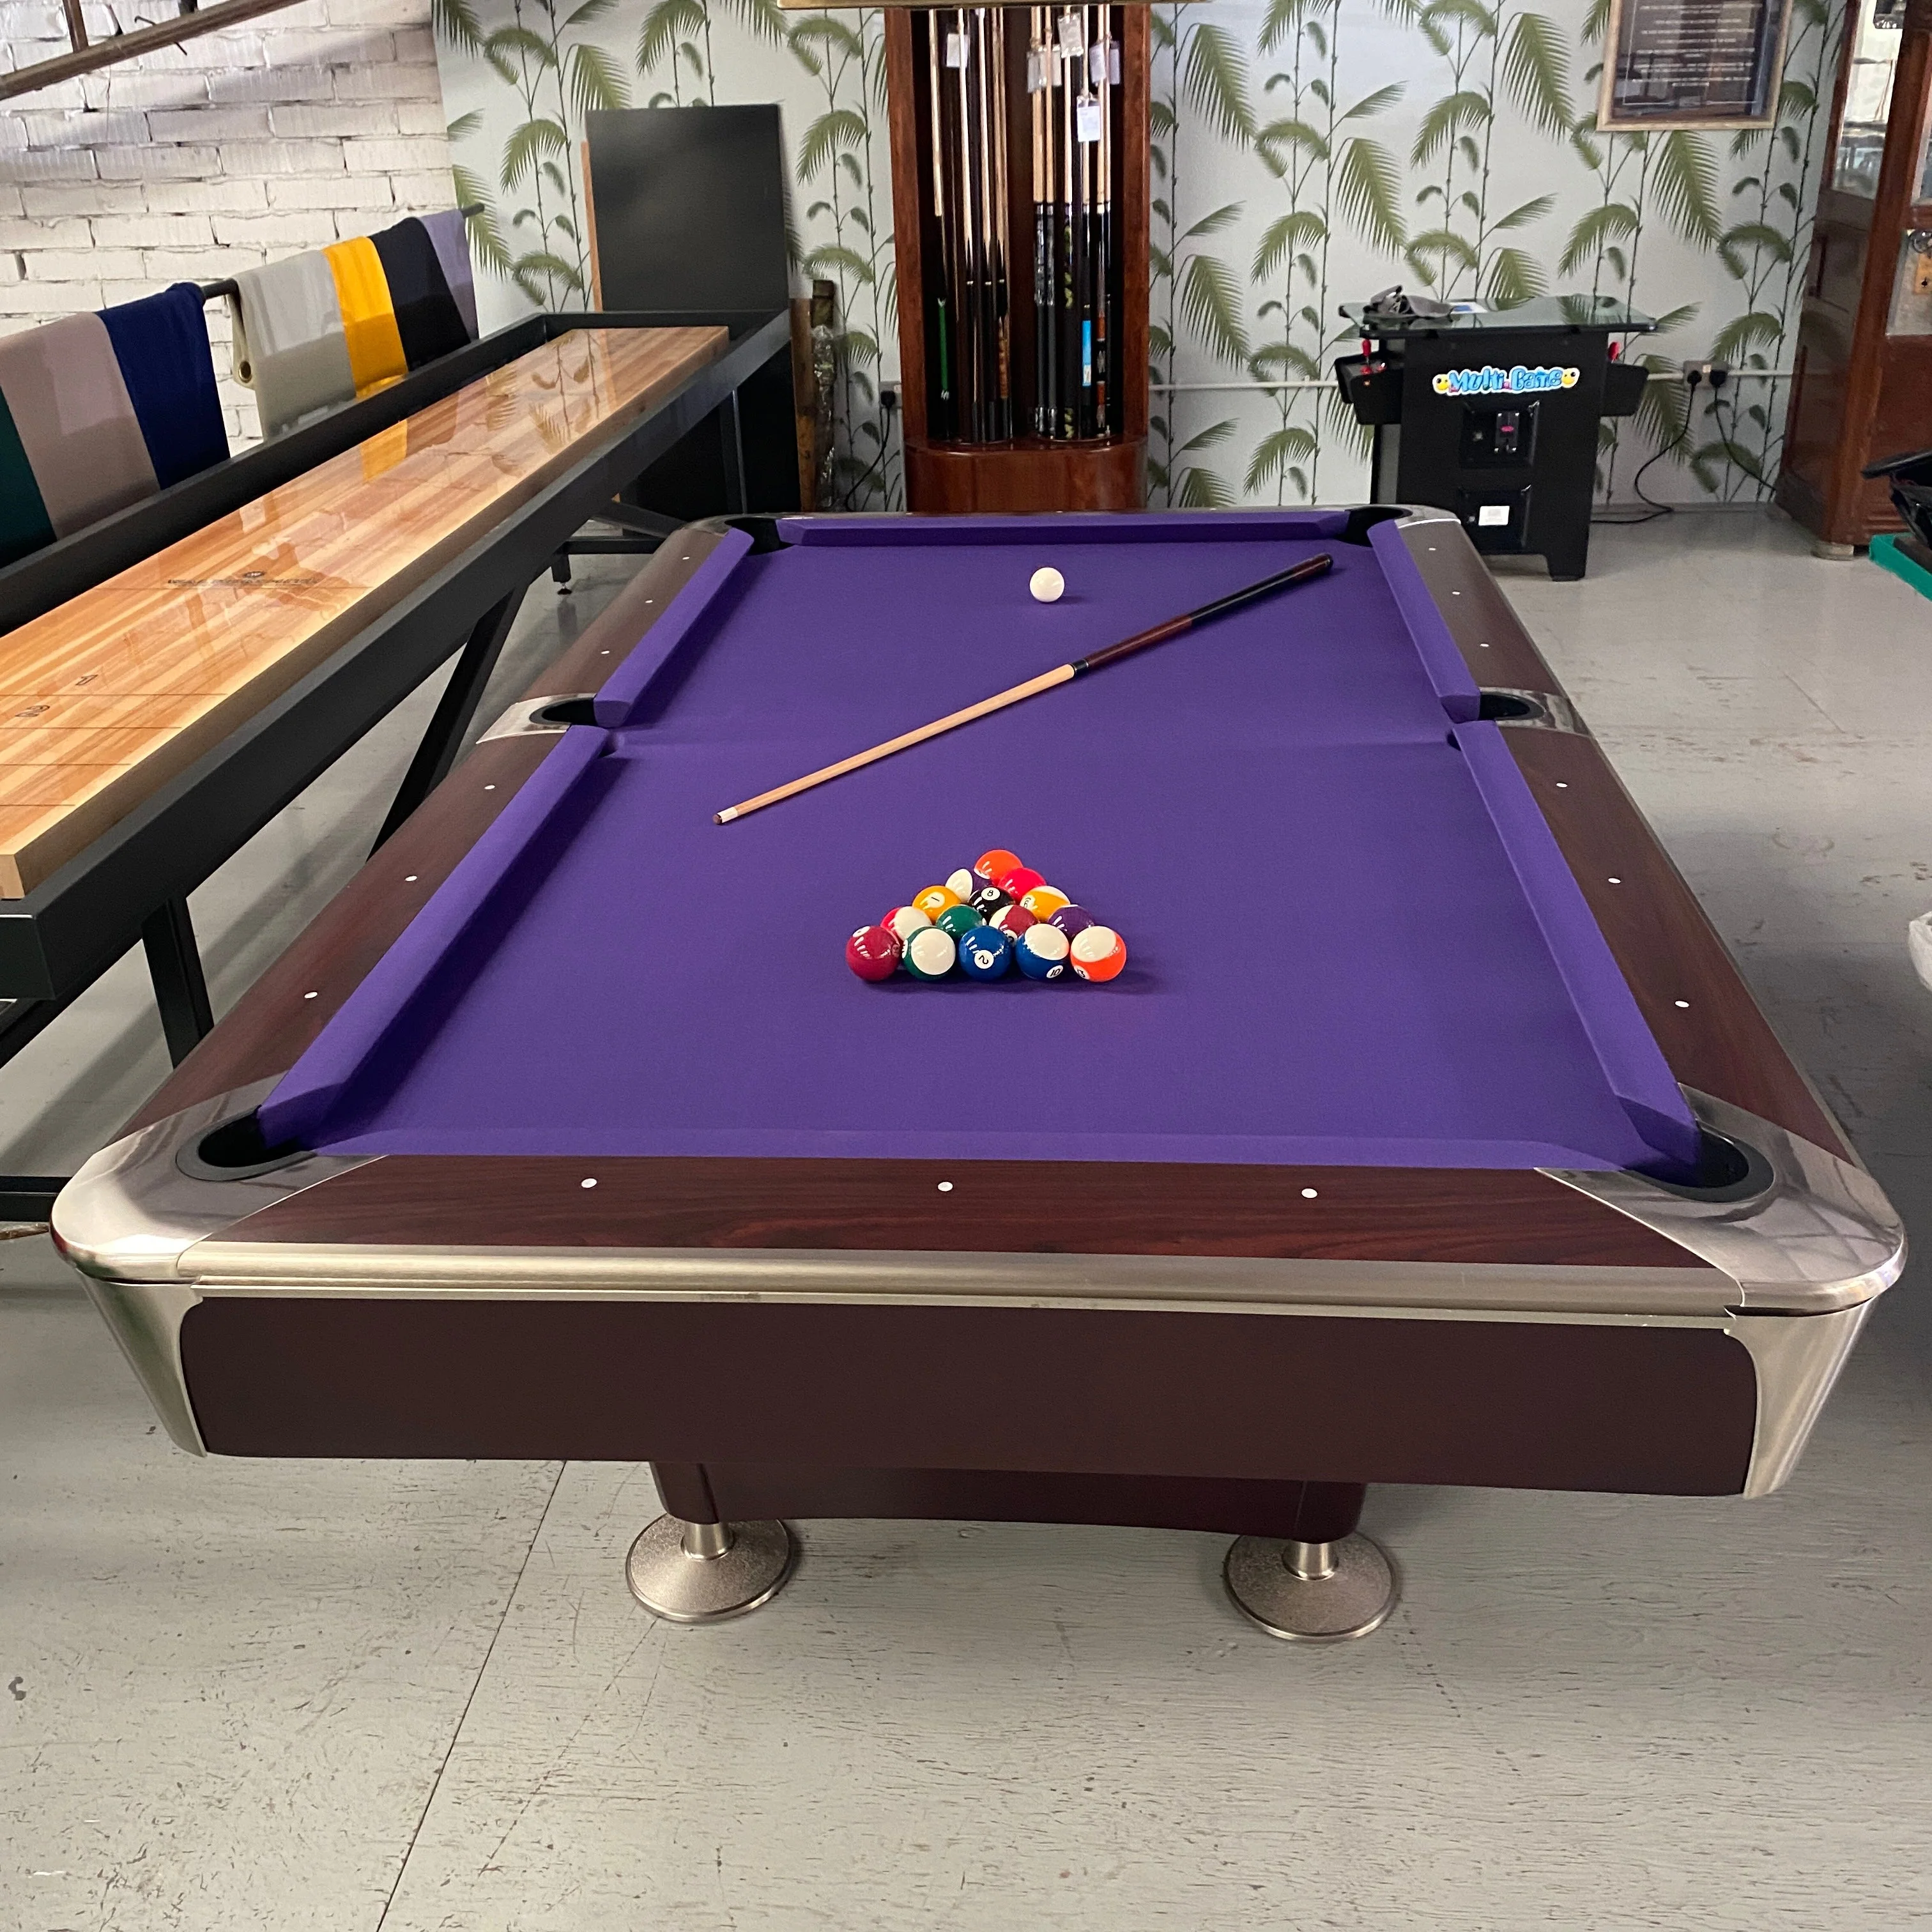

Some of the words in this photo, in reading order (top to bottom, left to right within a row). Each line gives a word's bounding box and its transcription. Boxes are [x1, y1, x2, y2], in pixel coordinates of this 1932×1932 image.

[1448, 367, 1505, 392] Multi
[1511, 368, 1563, 391] Game
[75, 674, 98, 686] 1
[15, 705, 50, 717] 2
[986, 889, 994, 897] 8
[978, 954, 989, 965] 2
[1050, 967, 1061, 977] 10
